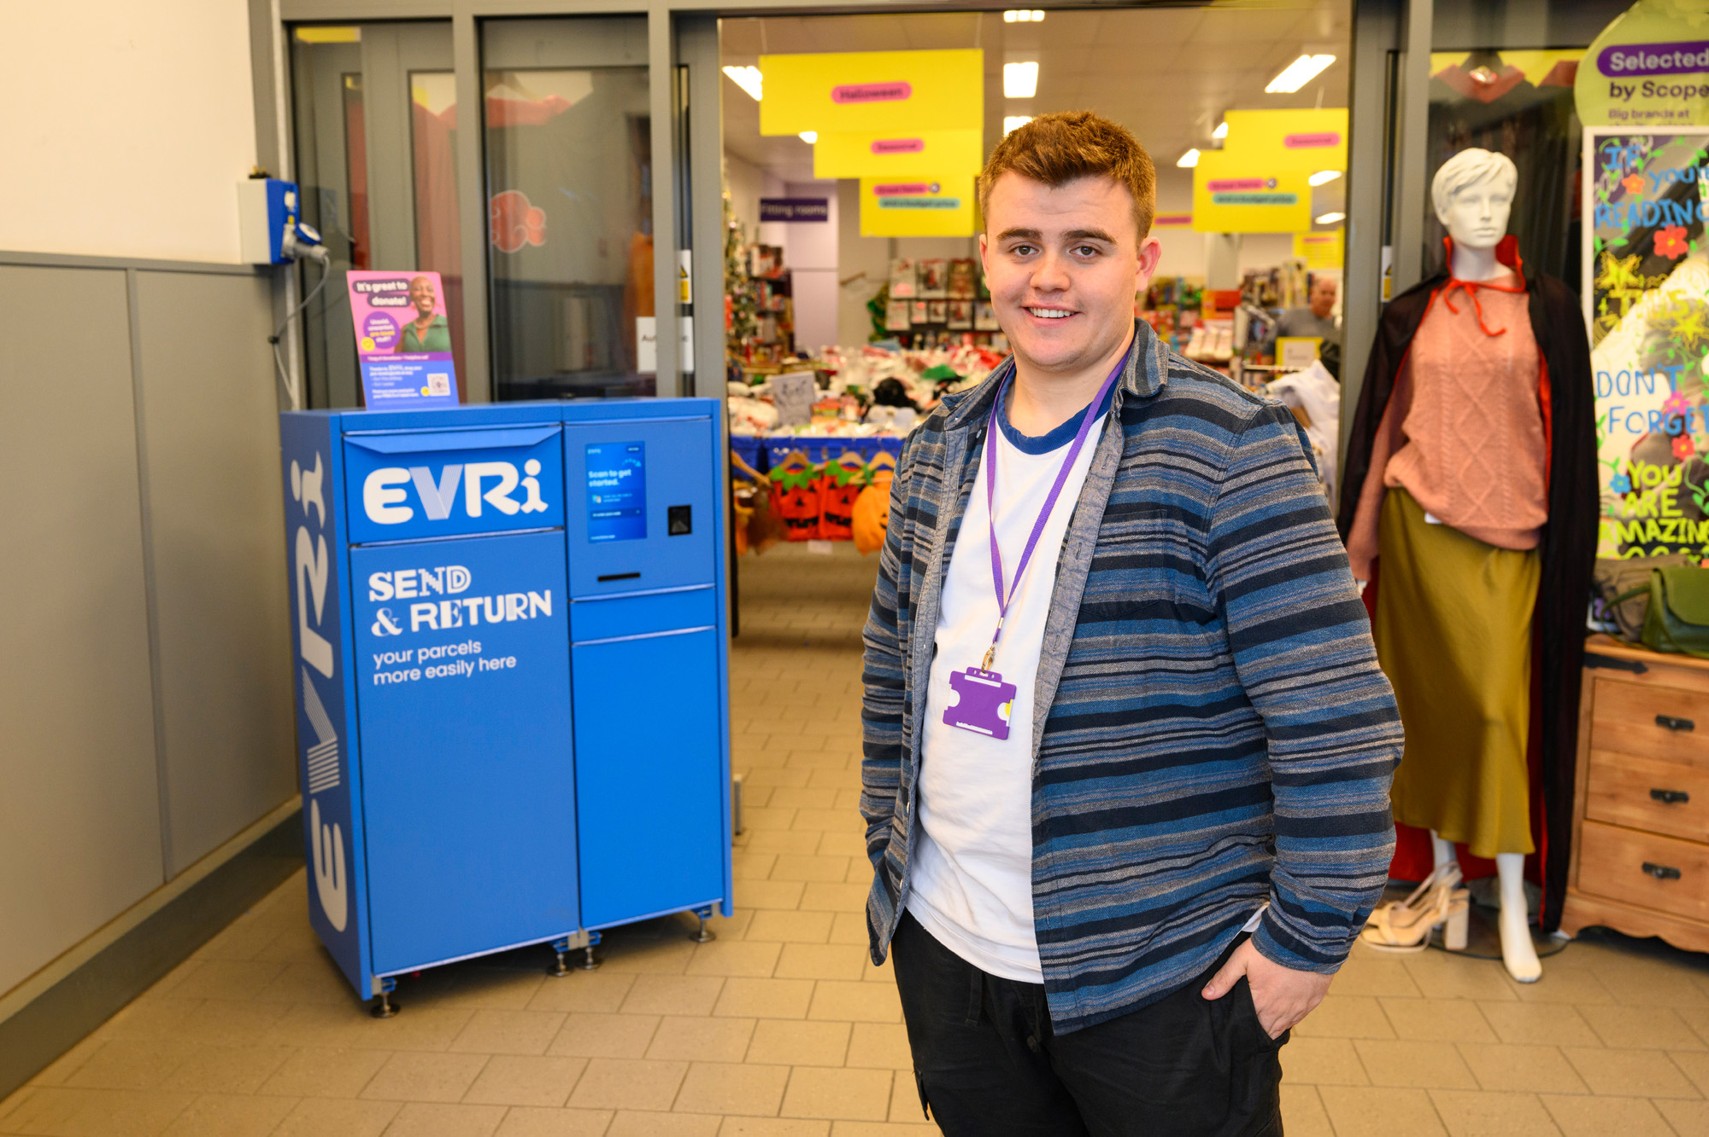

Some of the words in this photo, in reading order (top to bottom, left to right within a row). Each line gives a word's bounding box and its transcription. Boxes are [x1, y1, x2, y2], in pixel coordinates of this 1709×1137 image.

[1609, 48, 1709, 72] Selected
[840, 88, 903, 99] Halloween
[1609, 81, 1635, 101] by
[1641, 80, 1709, 101] Scope
[1608, 108, 1629, 120] Big
[1631, 108, 1674, 119] brands
[1678, 108, 1689, 118] at
[1604, 146, 1641, 170] IF
[396, 280, 408, 291] to
[1596, 362, 1685, 398] DON'T
[588, 470, 608, 479] Scan
[609, 469, 618, 478] to
[618, 468, 632, 479] get
[1626, 459, 1683, 489] YOU
[1621, 488, 1684, 518] ARE
[368, 565, 472, 602] SEND
[371, 607, 403, 637] &
[410, 590, 552, 633] RETURN
[373, 649, 414, 670] your
[418, 639, 482, 664] parcels
[373, 667, 421, 686] more
[425, 658, 475, 679] easily
[479, 655, 517, 672] here
